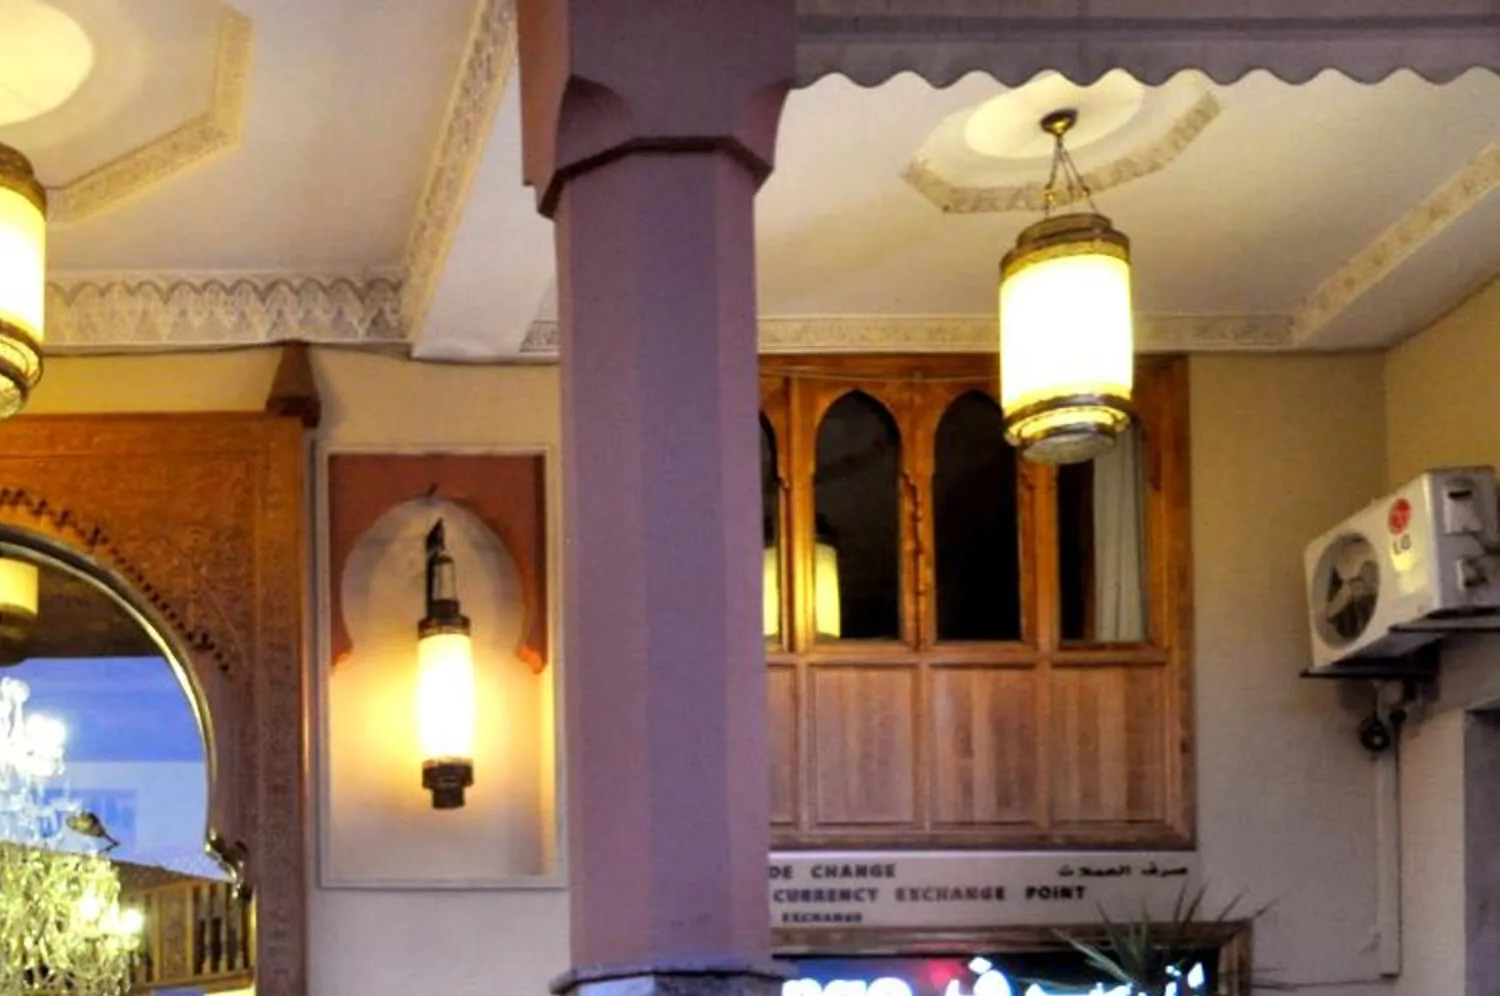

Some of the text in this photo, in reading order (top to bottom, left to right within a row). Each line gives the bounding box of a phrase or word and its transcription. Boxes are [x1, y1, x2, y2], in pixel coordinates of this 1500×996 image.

[1393, 534, 1411, 554] LG
[768, 864, 896, 879] DE CHANGE
[773, 885, 1086, 902] CURRENCY EXCHANGE POINT
